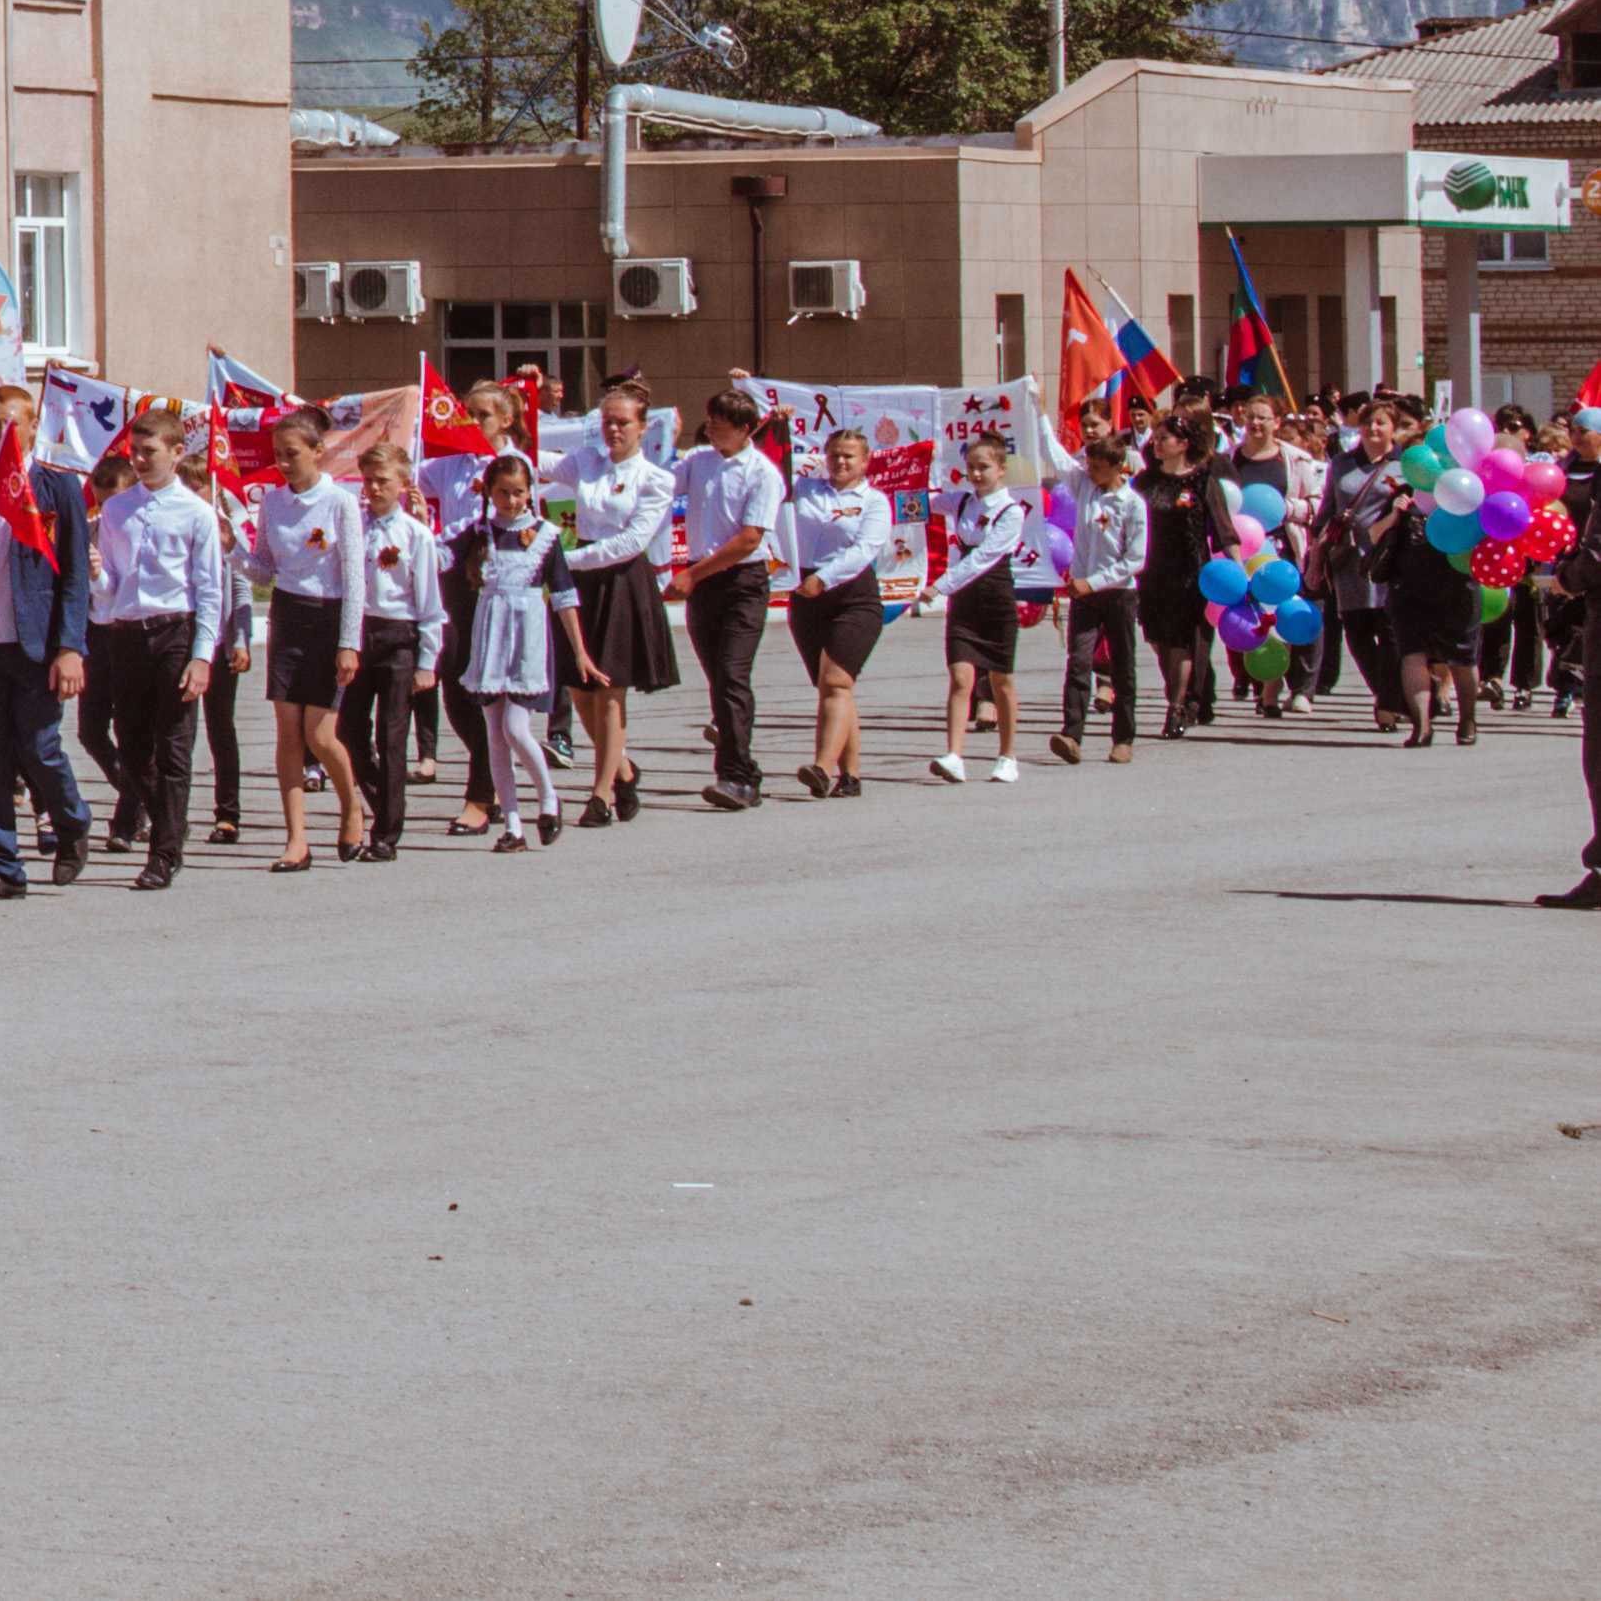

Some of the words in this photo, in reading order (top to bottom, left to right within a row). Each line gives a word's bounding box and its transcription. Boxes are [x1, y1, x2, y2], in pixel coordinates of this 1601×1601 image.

[1494, 175, 1531, 209] БАНК
[1588, 179, 1601, 197] 2
[766, 388, 779, 406] 9
